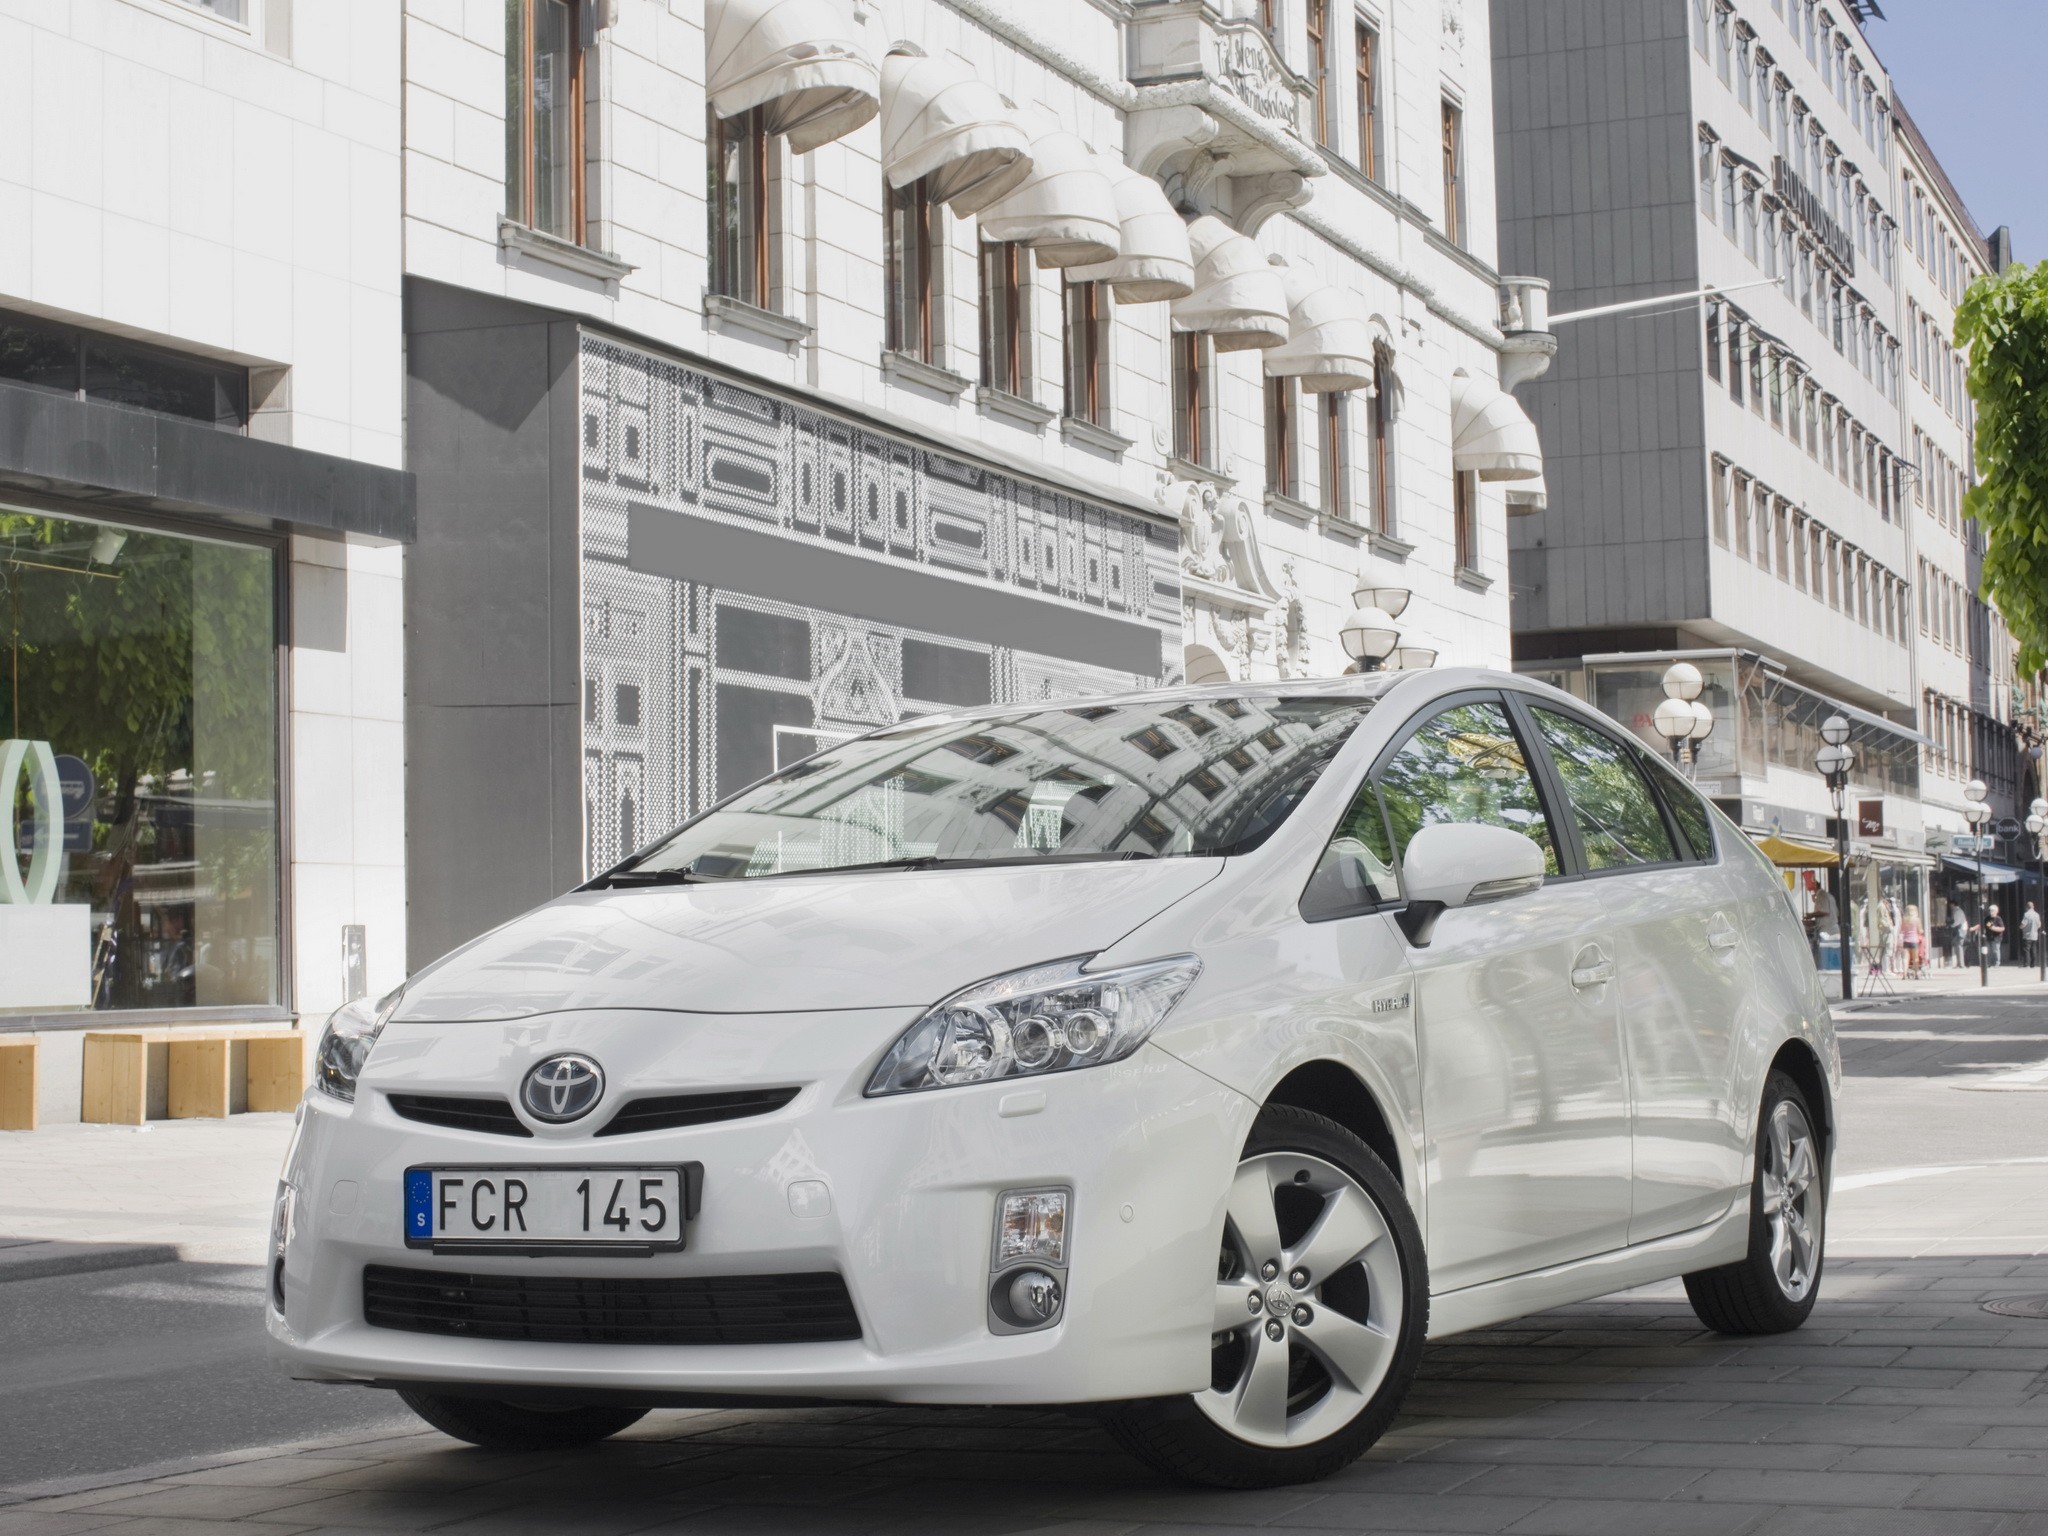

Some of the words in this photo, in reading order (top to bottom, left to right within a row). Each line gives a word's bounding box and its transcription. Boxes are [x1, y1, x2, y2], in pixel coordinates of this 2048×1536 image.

[1998, 824, 2019, 832] bank
[439, 1178, 528, 1231] FCR
[576, 1178, 666, 1232] 145
[416, 1213, 426, 1227] S
